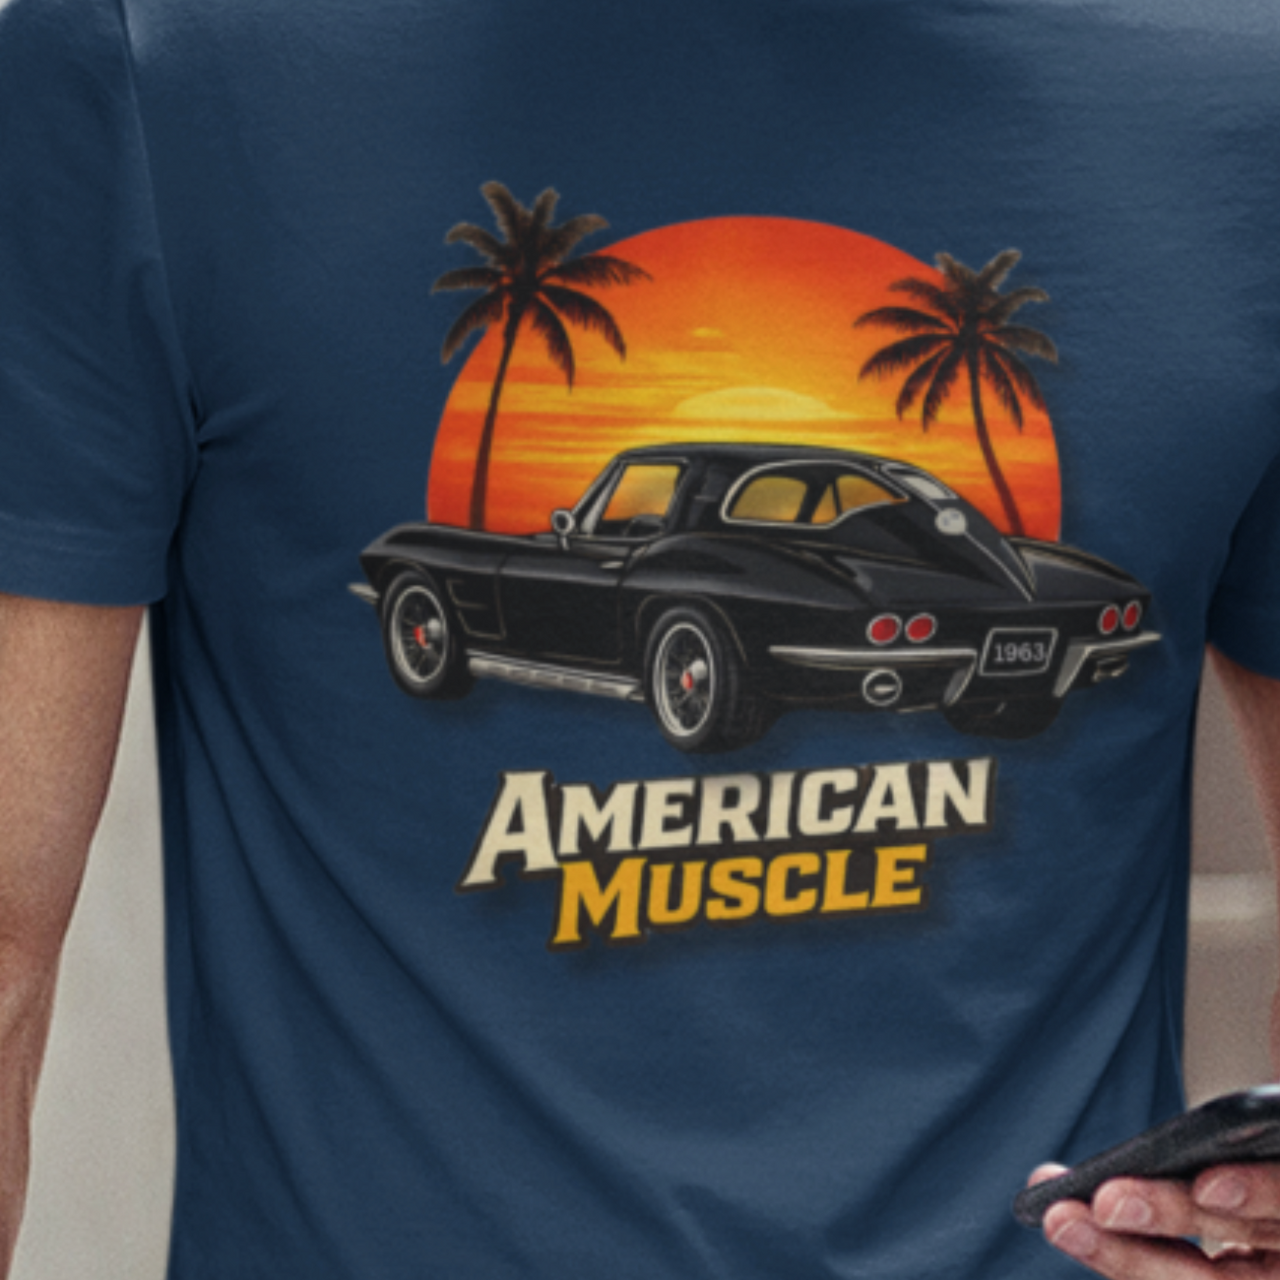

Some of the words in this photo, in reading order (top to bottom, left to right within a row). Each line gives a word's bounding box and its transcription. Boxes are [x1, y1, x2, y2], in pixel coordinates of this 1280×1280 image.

[994, 642, 1045, 663] 1963
[461, 757, 992, 887] AMERICAN
[552, 843, 928, 945] MUSCLE
